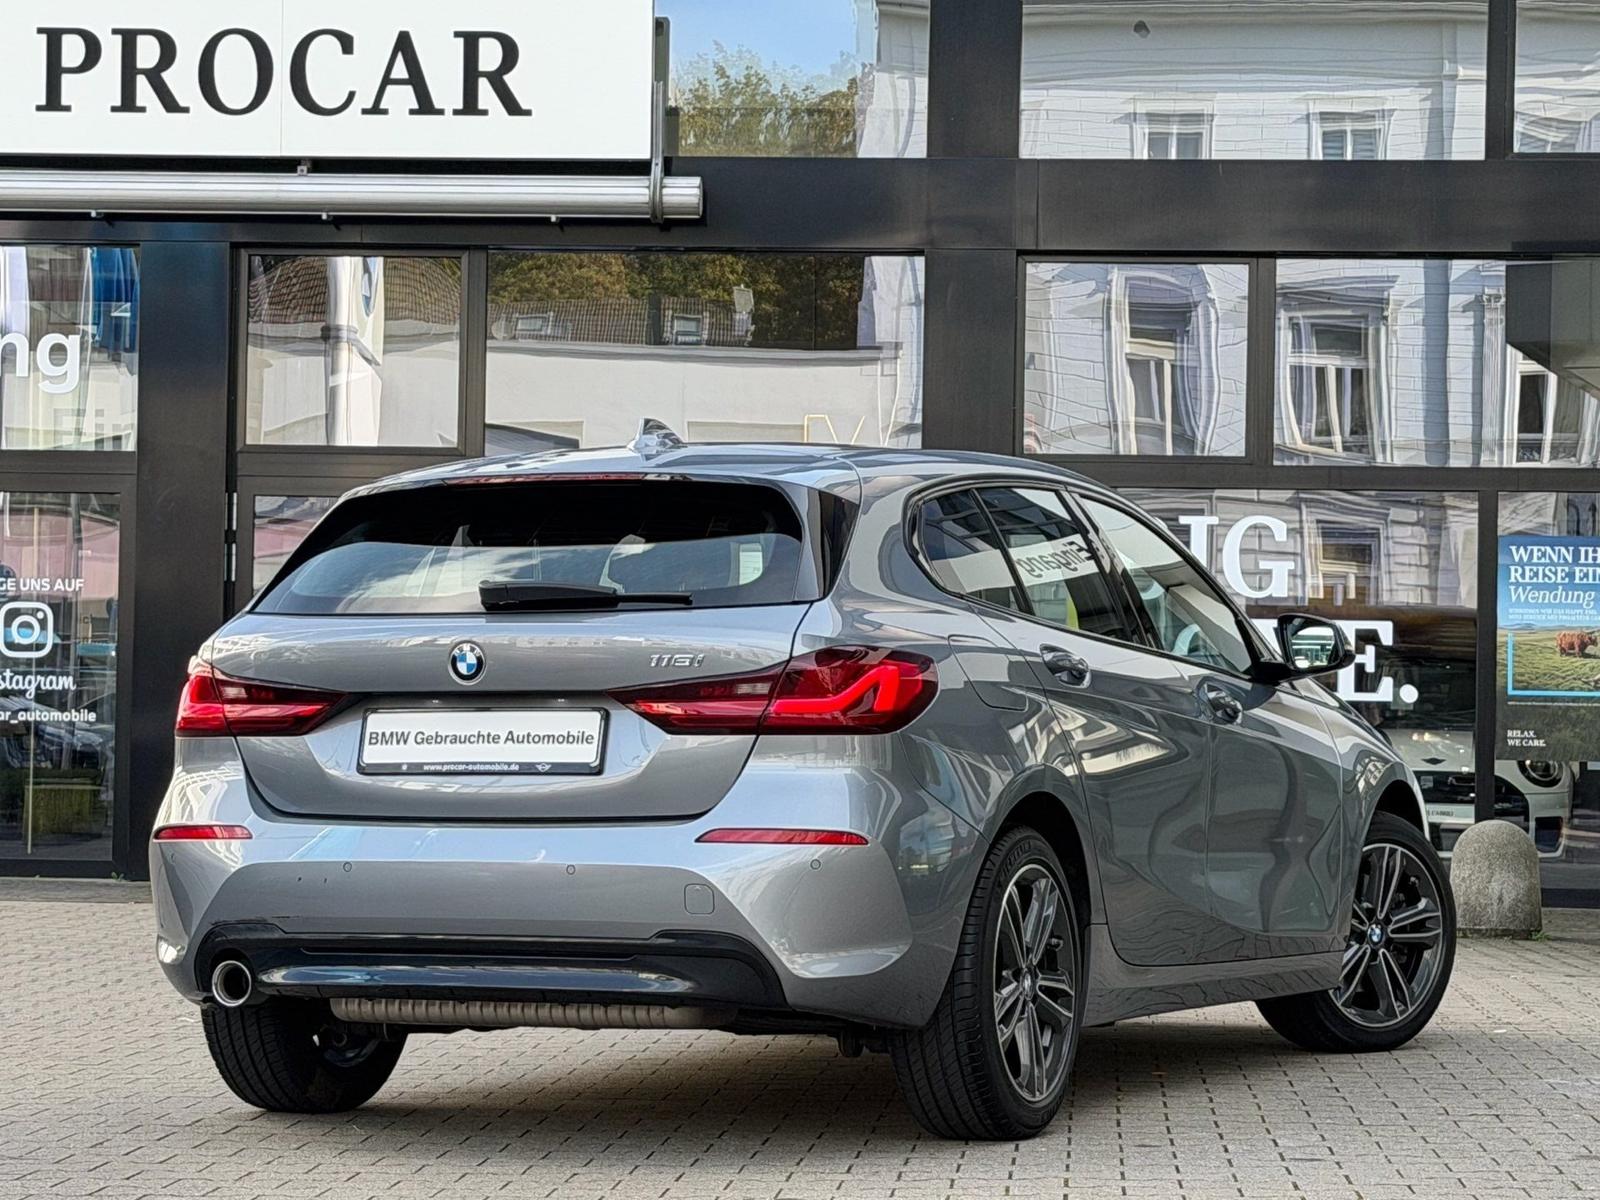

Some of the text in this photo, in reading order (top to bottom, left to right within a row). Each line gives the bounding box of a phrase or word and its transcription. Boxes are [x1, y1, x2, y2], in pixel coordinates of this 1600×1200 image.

[36, 27, 532, 116] PROCAR
[1509, 545, 1574, 563] WENN
[1508, 565, 1600, 584] REISE EI
[20, 577, 51, 591] UNS
[54, 577, 85, 592] AUF
[1508, 586, 1595, 609] Wendung
[368, 729, 595, 746] BMW Gebrauchte Automobile
[1506, 729, 1538, 738] RELAX.
[1507, 738, 1547, 748] WE CARE.
[423, 762, 520, 771] www.procar-automobile.de
